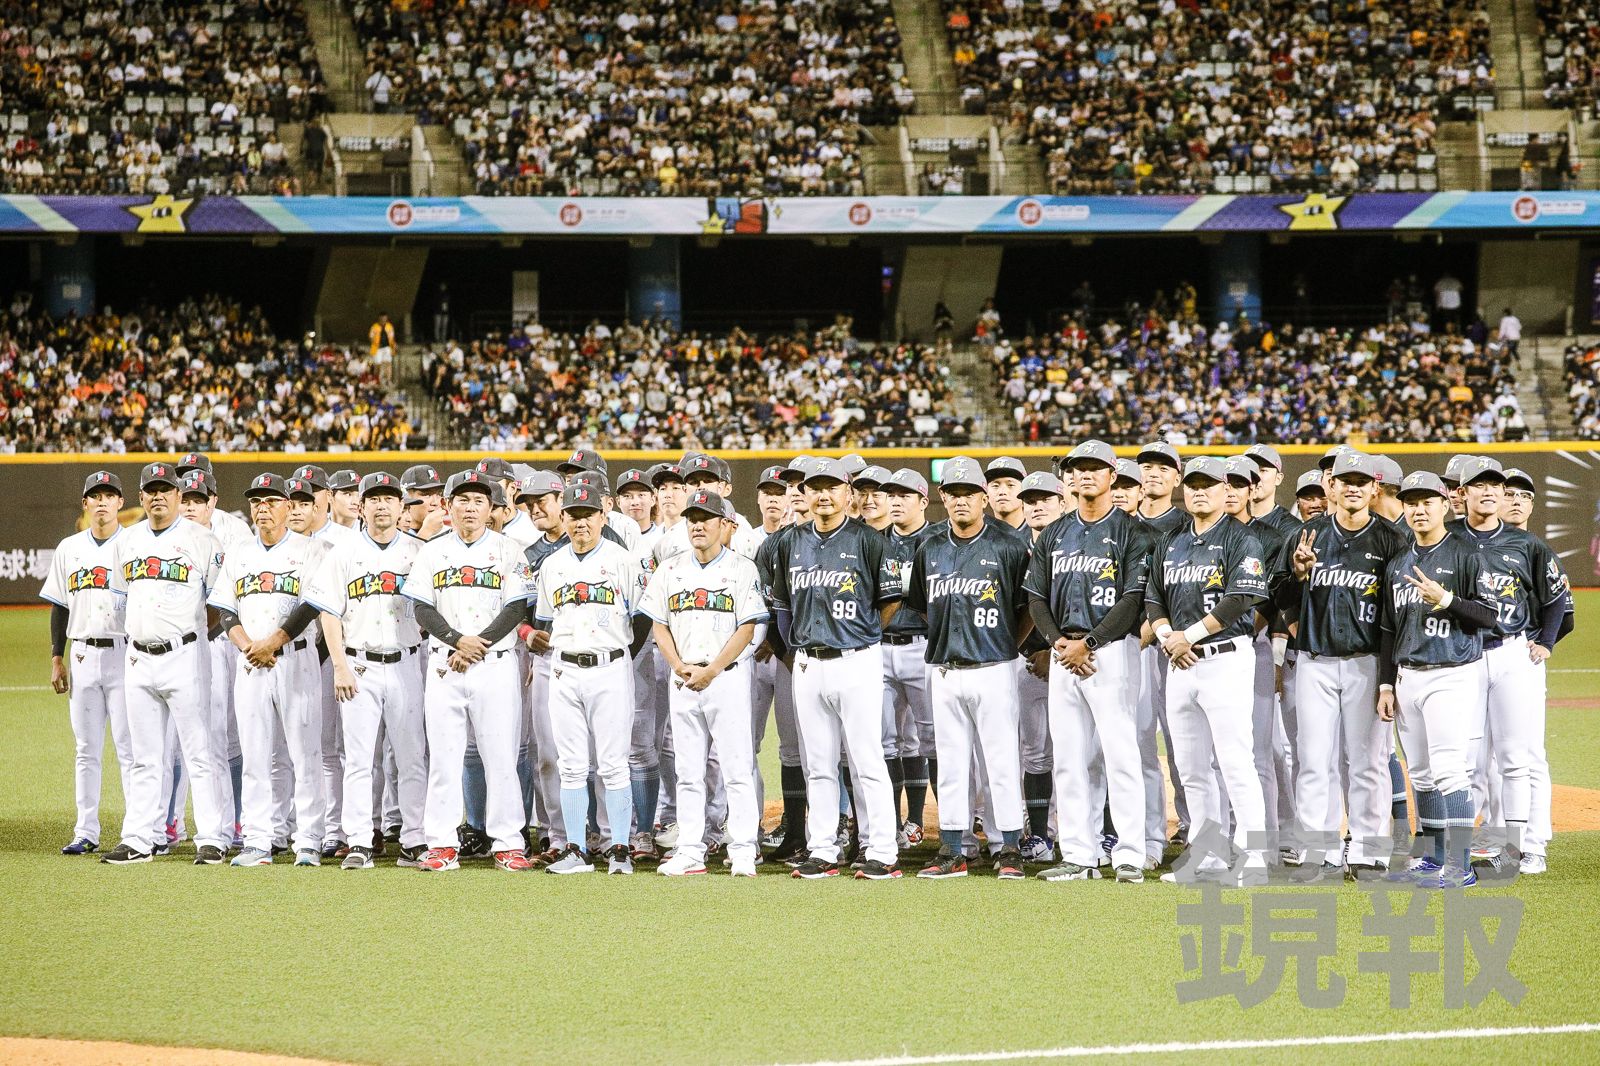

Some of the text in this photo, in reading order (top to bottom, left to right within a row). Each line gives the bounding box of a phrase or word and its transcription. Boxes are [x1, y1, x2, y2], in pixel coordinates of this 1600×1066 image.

[1052, 549, 1113, 580] Taiwan
[1163, 560, 1218, 591] Taiwan
[1310, 562, 1378, 591] Taiwan
[790, 564, 852, 595] Taiwan
[927, 570, 993, 603] Taiwan
[1090, 585, 1116, 607] 28
[832, 599, 857, 620] 99
[973, 607, 999, 629] 66
[1358, 600, 1378, 623] 19
[1496, 601, 1517, 625] 17
[1424, 616, 1451, 639] 90
